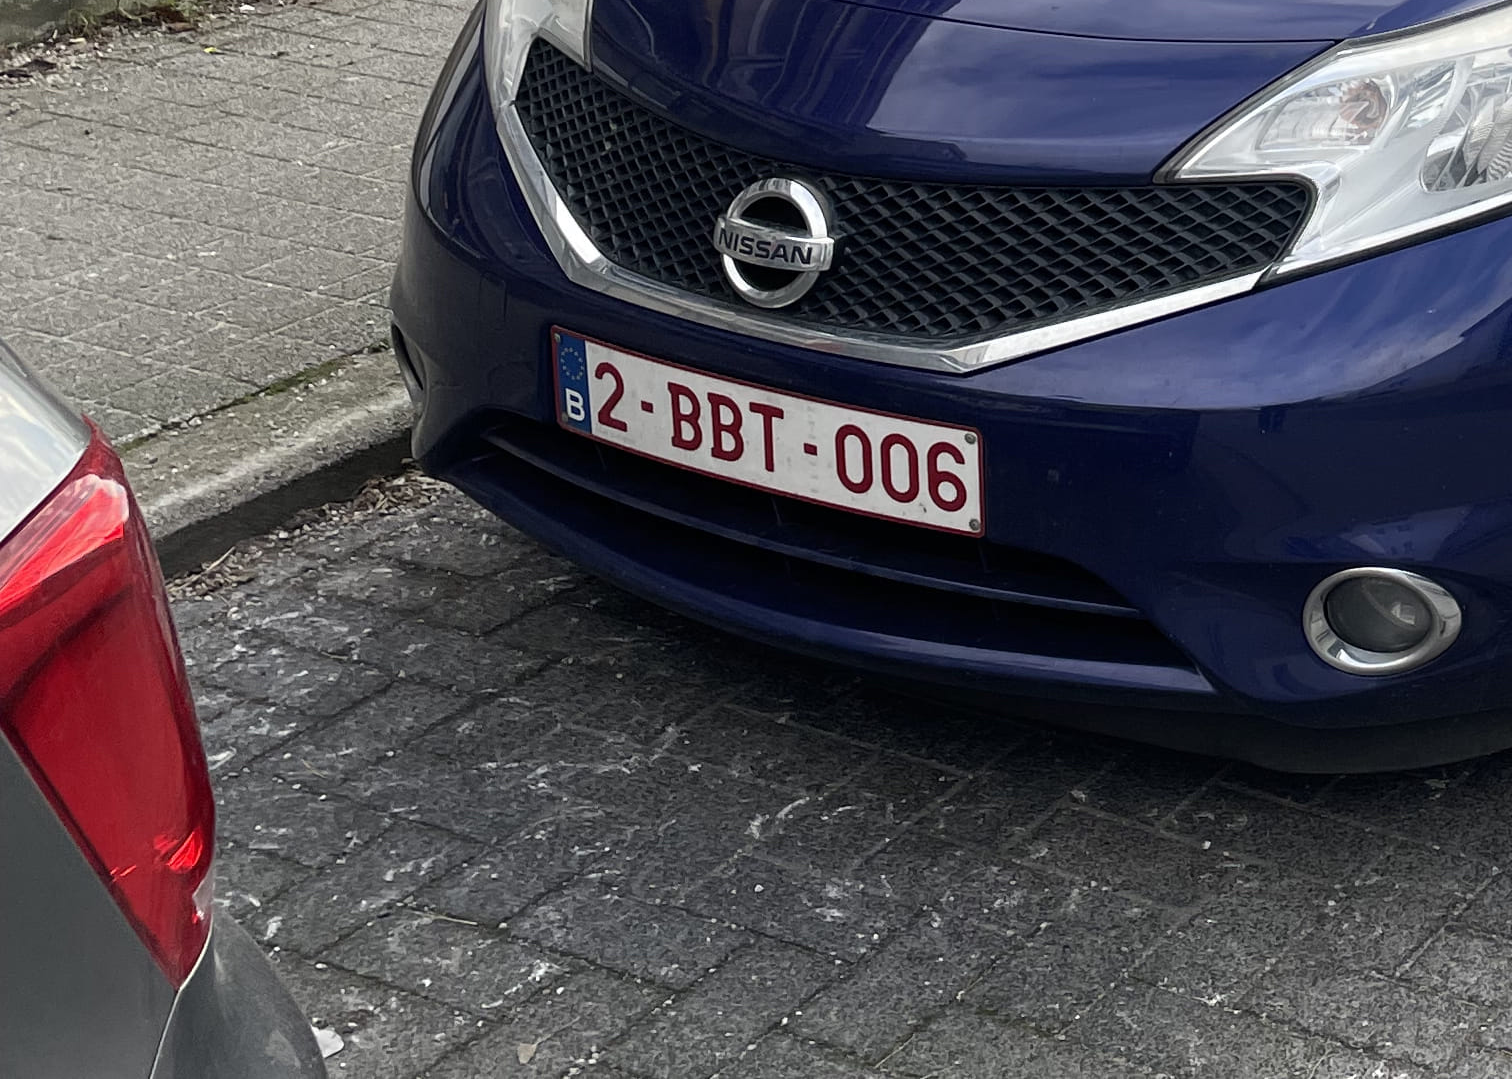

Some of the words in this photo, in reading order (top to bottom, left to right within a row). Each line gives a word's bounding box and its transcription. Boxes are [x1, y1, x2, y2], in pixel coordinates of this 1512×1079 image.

[718, 227, 813, 265] NISSAN
[565, 387, 586, 422] B
[594, 361, 968, 512] 2-BBT-006
